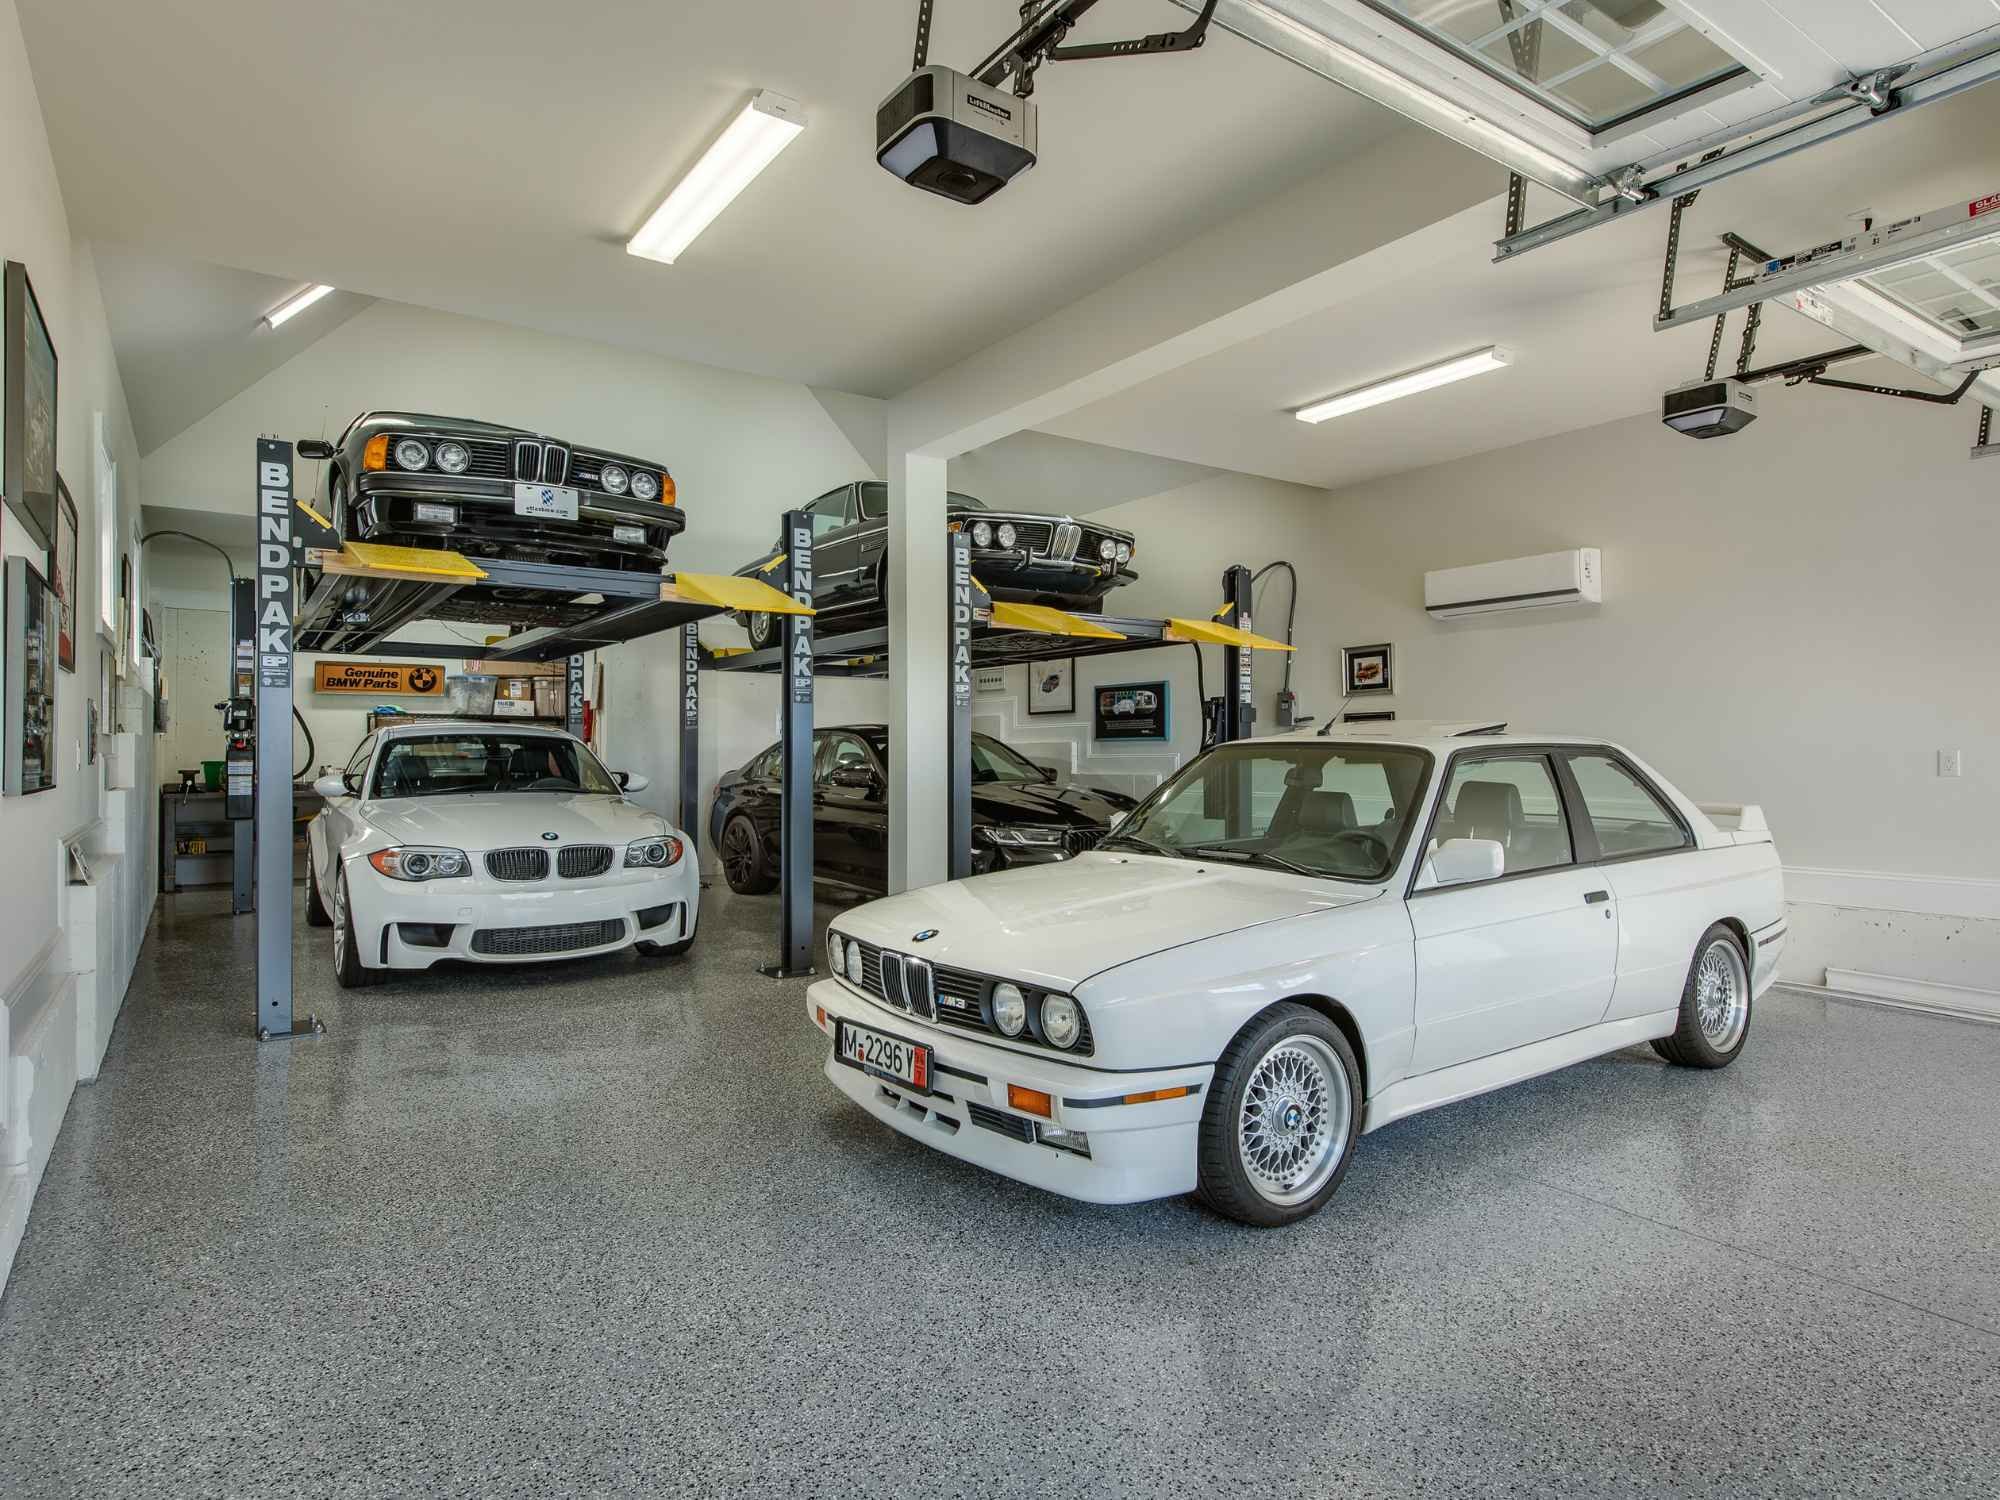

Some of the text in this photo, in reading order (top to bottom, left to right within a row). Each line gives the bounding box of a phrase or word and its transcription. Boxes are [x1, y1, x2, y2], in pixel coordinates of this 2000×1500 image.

[260, 461, 290, 653] BENDPAK
[794, 528, 812, 677] BENDPAK
[954, 548, 970, 683] BENDPAK
[326, 677, 399, 689] BMW Parts
[344, 667, 399, 679] Genuine
[570, 654, 583, 707] DPAK
[686, 623, 698, 710] BENDPAK
